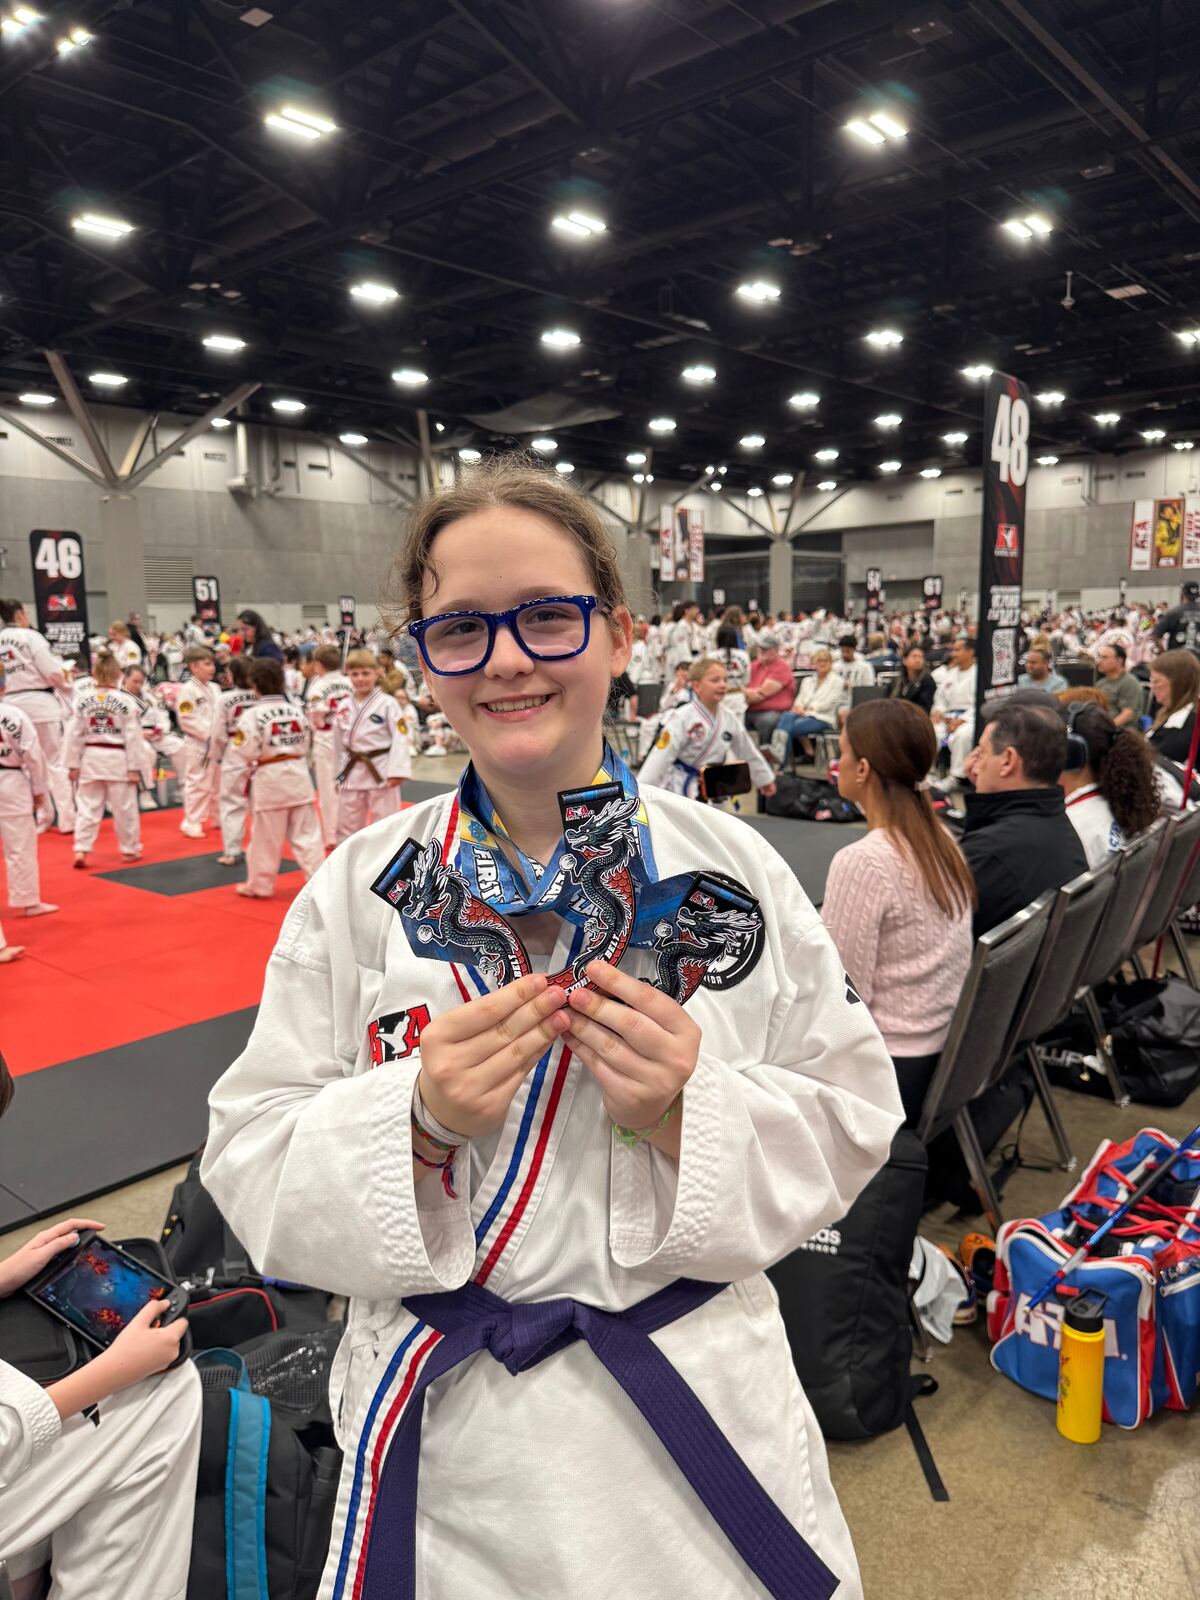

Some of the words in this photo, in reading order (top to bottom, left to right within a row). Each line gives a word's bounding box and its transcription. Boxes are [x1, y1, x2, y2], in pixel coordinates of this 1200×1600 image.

[991, 394, 1030, 487] 48
[35, 538, 82, 579] 46
[195, 578, 218, 602] 51
[474, 847, 500, 904] FIRST
[605, 933, 621, 959] BELT
[564, 976, 591, 997] EYON
